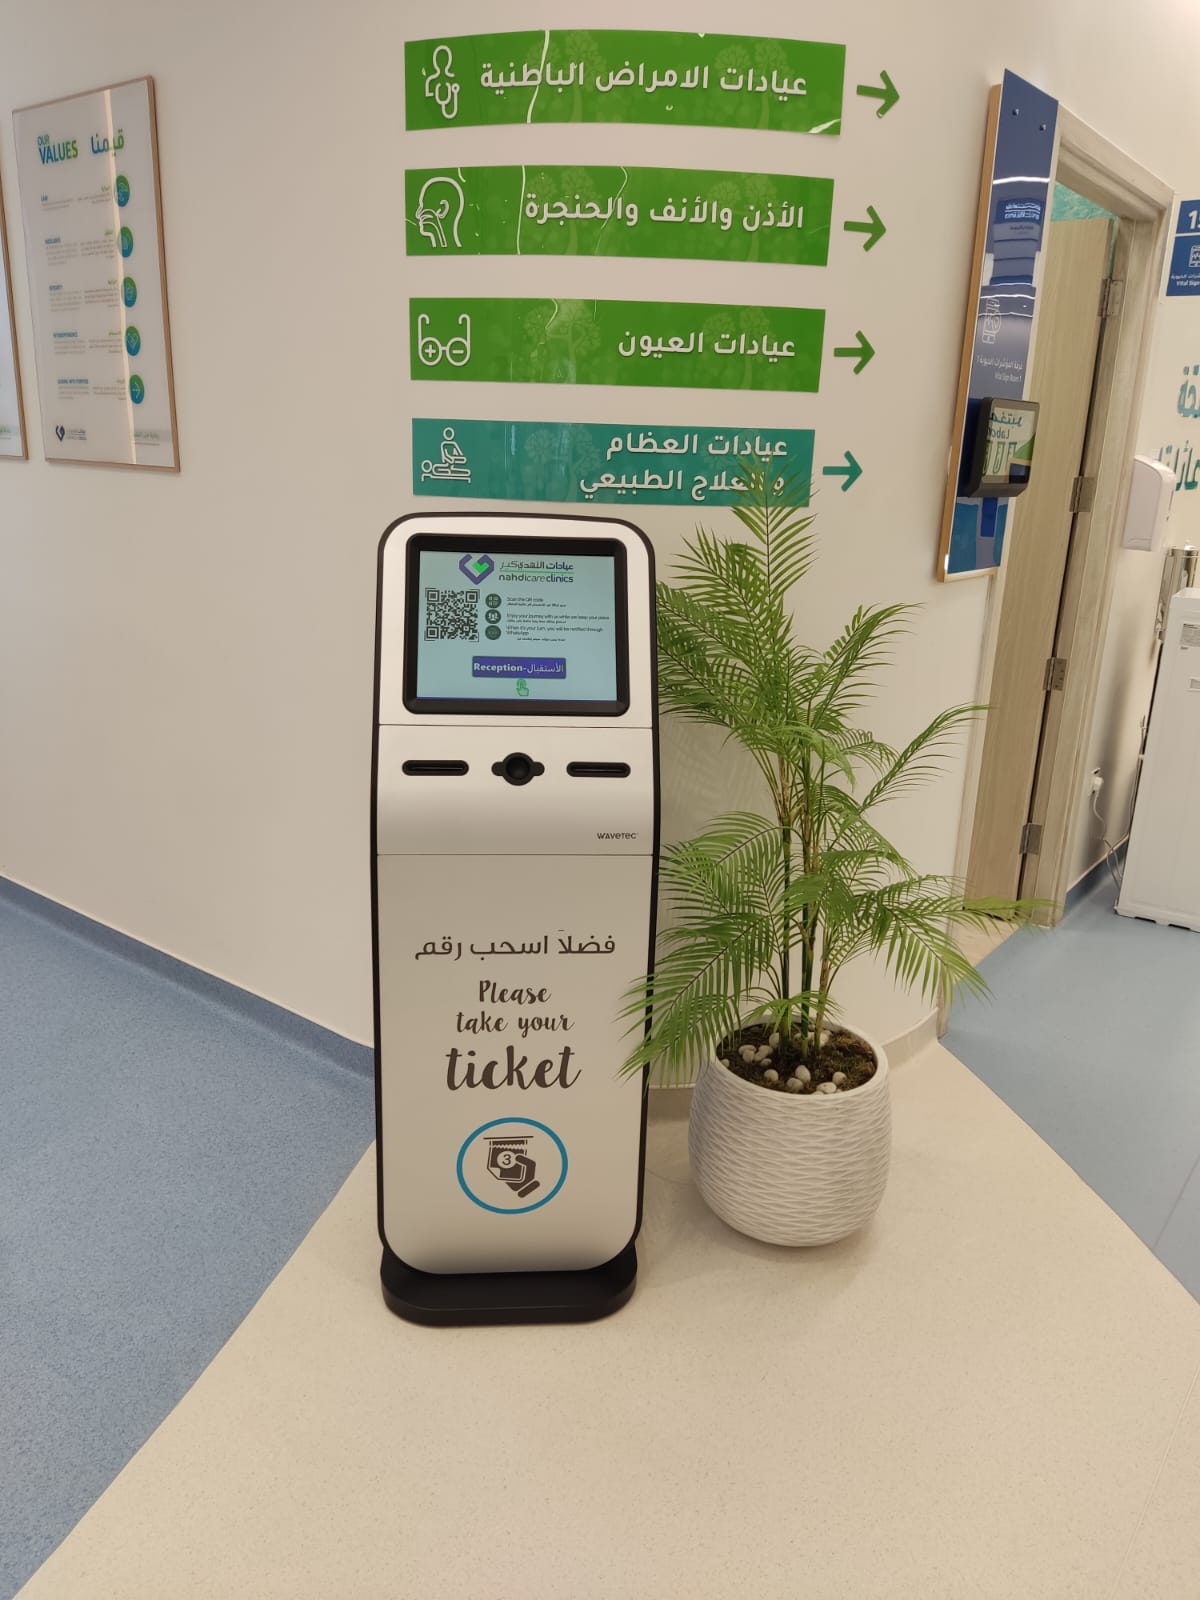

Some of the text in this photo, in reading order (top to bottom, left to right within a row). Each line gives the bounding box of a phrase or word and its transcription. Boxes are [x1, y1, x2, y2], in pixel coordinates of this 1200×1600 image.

[480, 61, 808, 102] عيادات الامراض الباطنية
[39, 139, 78, 165] VALUES
[90, 128, 125, 157] قيمنا
[525, 192, 804, 232] الأذن والأنف والحنجرة
[617, 329, 796, 363] عيادات العيون
[606, 431, 788, 463] عيادات العظام
[579, 469, 684, 500] الطبيعي
[414, 935, 463, 961] رقم
[470, 935, 549, 961] اسحب
[479, 979, 552, 1005] Please
[456, 1010, 575, 1038] take your
[445, 1045, 582, 1091] ticket
[501, 1153, 512, 1166] 3
